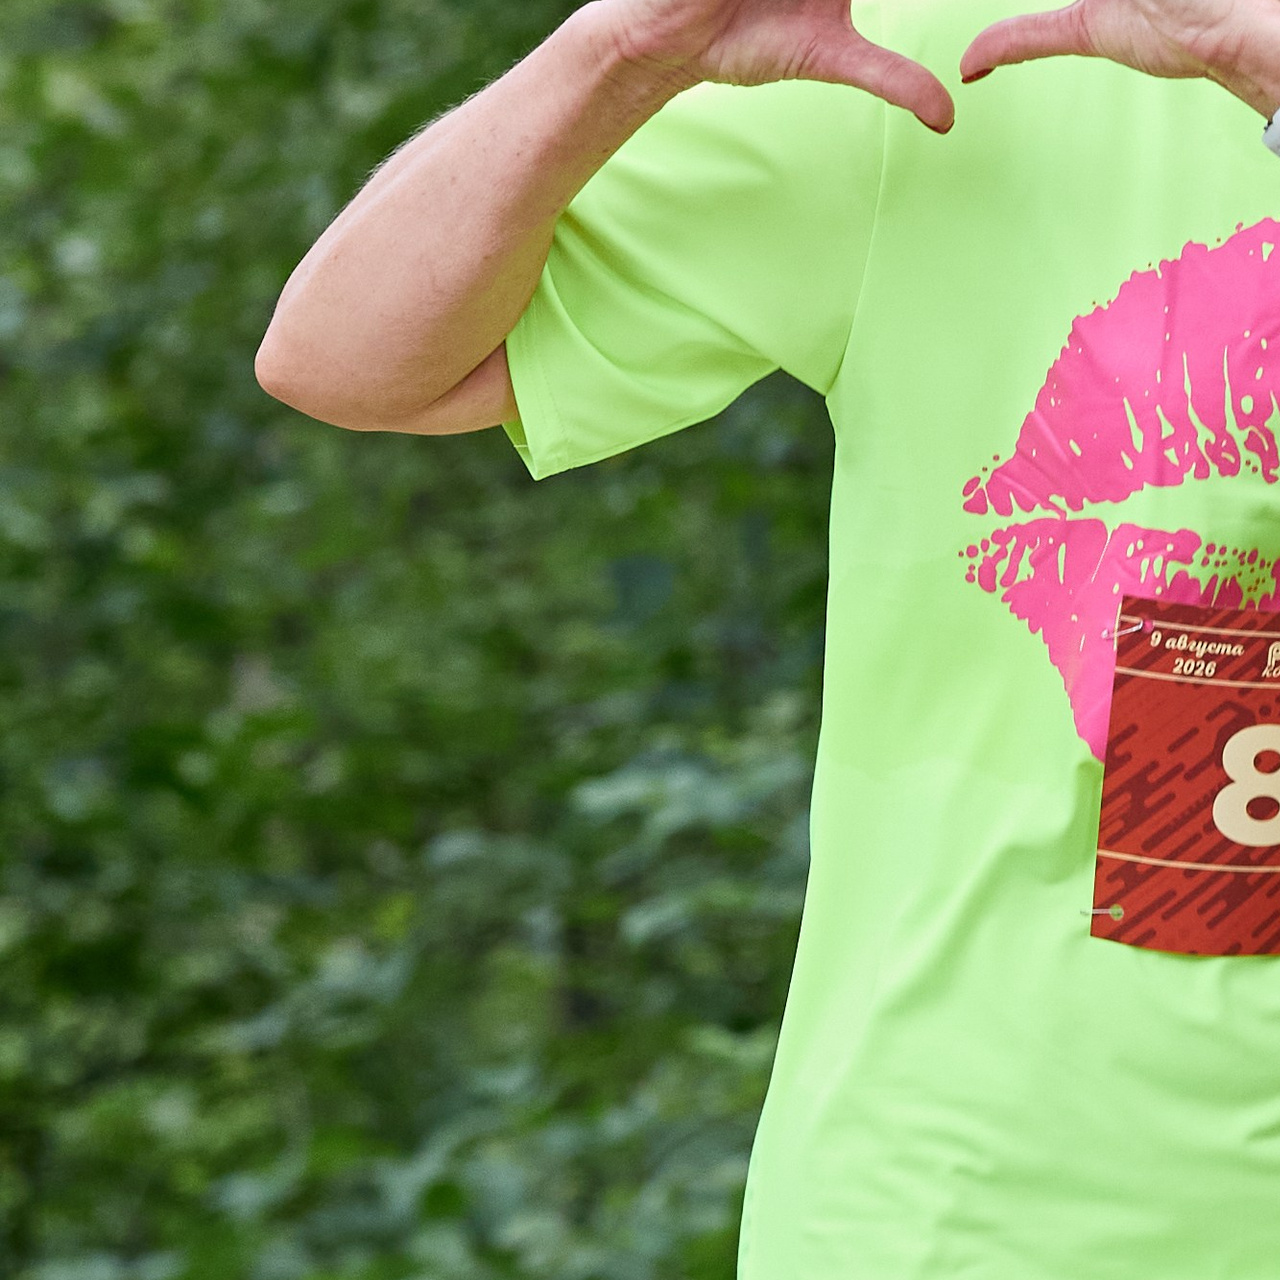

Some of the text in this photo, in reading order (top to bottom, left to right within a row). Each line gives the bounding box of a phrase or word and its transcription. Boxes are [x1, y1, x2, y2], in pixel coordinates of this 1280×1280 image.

[1150, 630, 1245, 659] 9 августа
[1172, 657, 1217, 678] 2026
